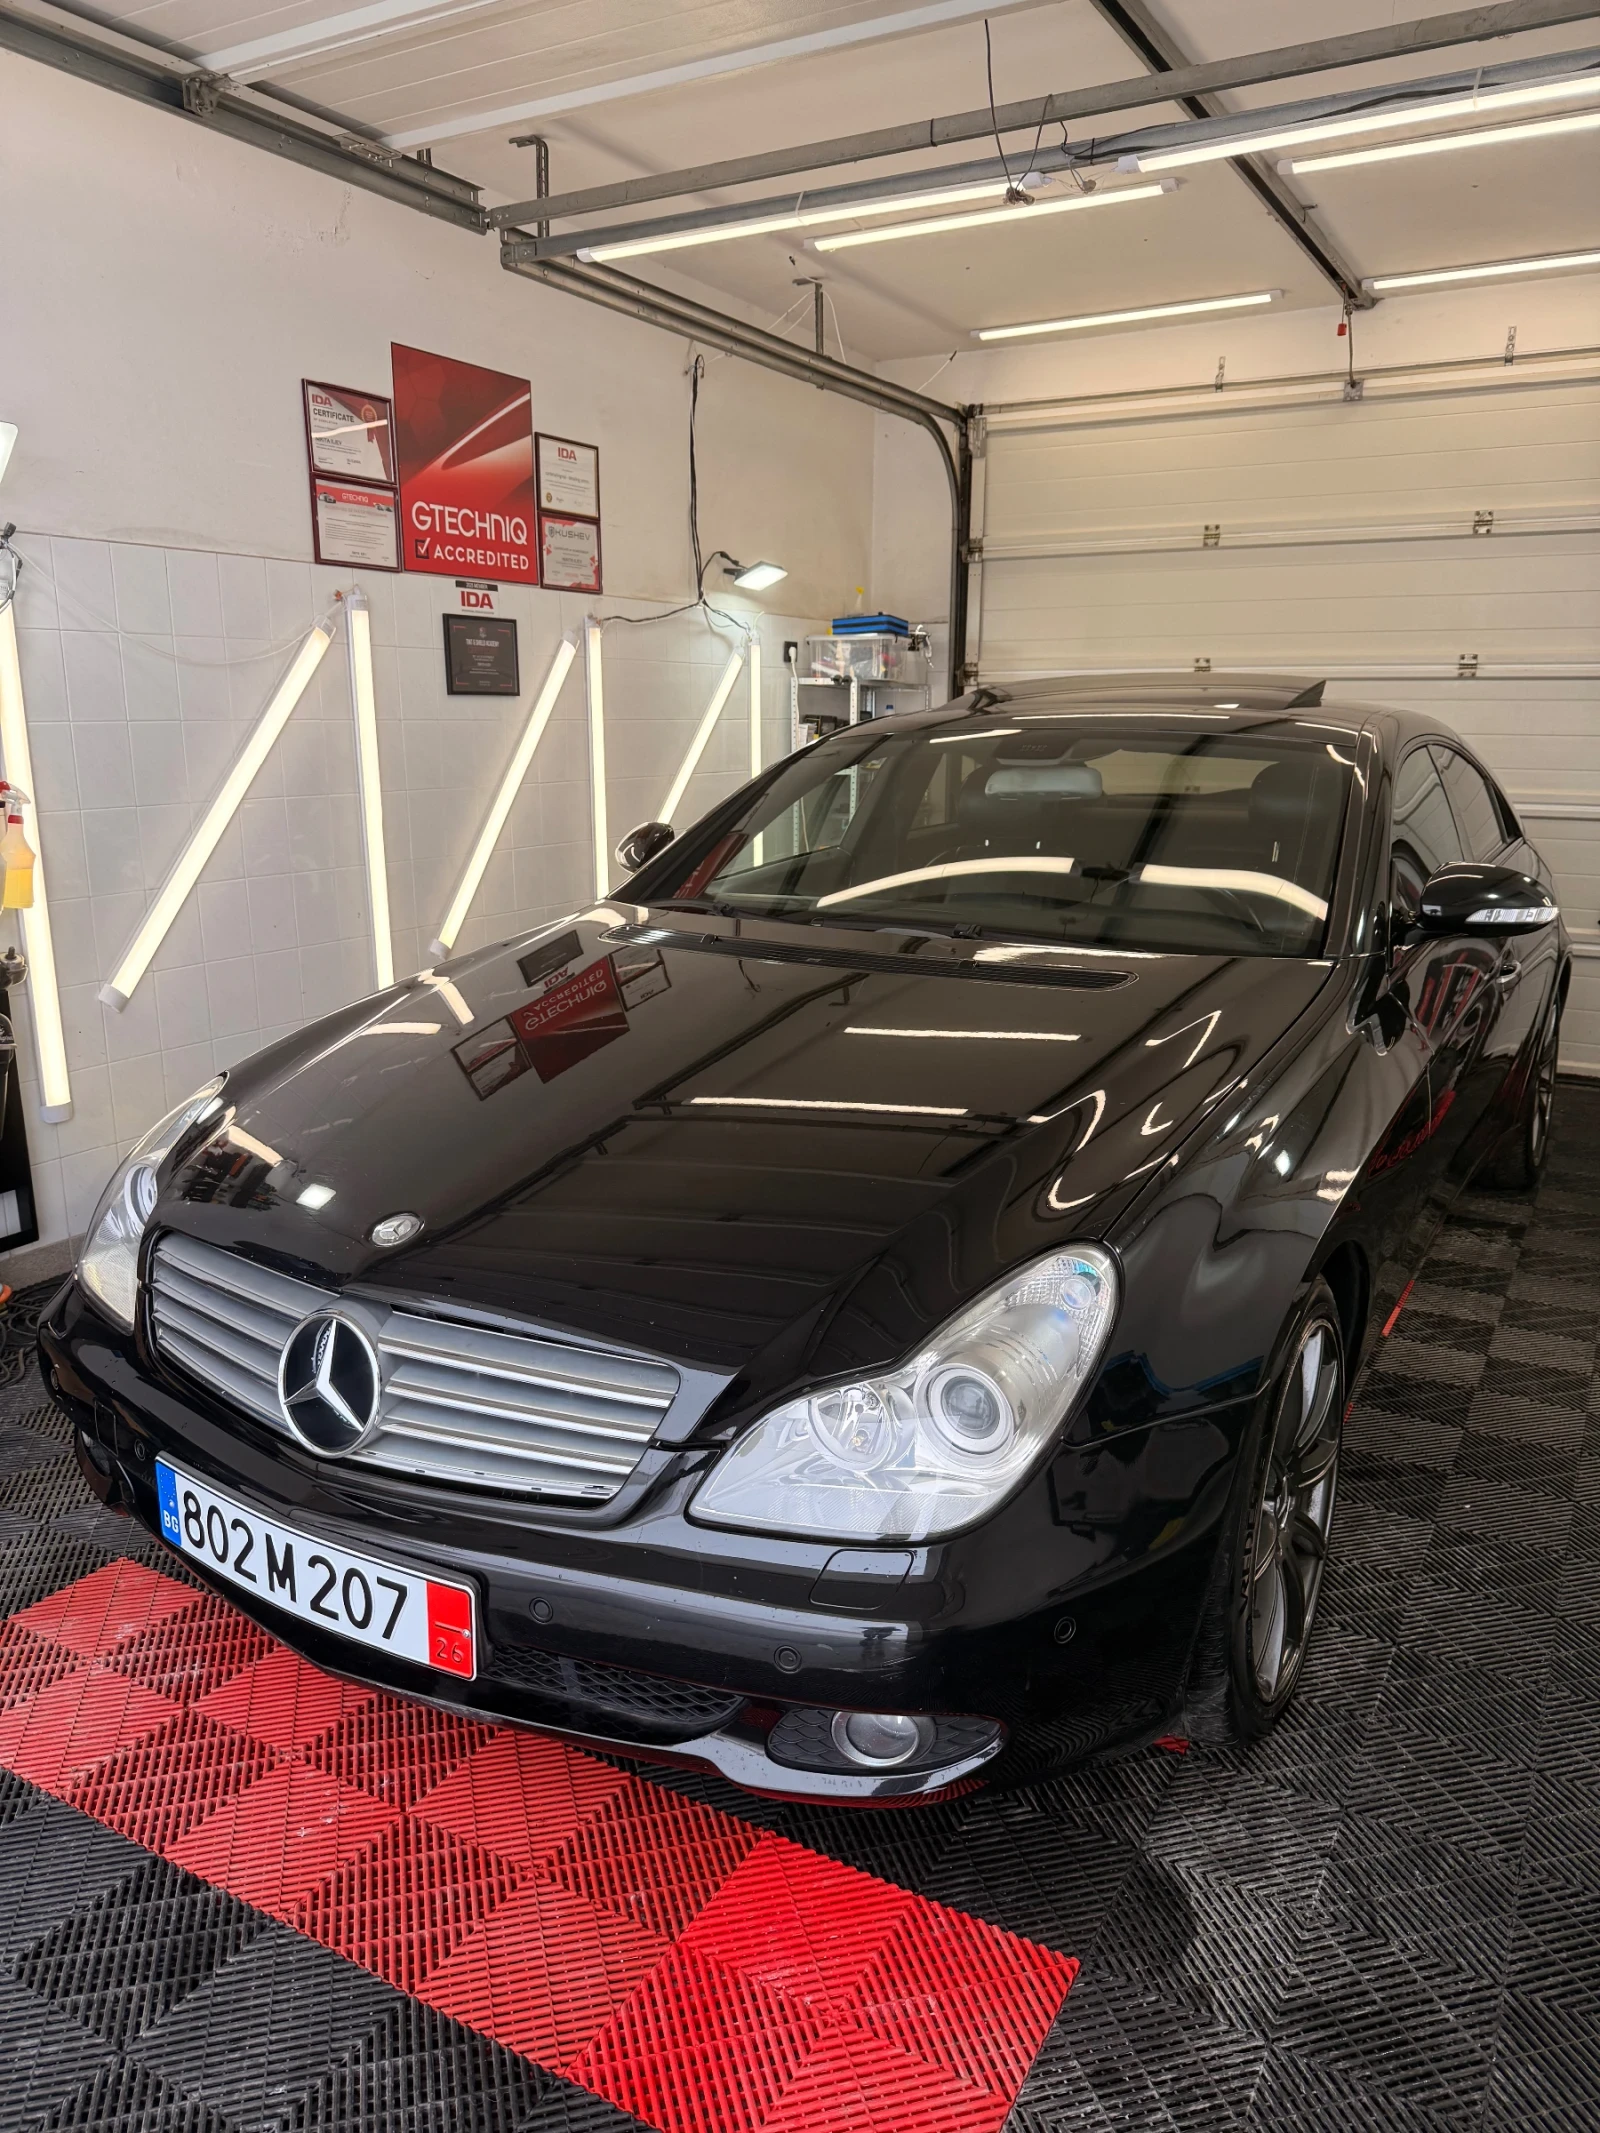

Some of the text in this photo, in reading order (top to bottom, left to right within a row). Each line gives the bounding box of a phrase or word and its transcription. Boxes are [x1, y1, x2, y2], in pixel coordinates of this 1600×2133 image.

[311, 394, 333, 407] IDA
[313, 408, 355, 423] CERTIFICATE
[557, 447, 577, 461] IDA
[341, 492, 369, 503] GTECHNIQ
[411, 500, 528, 546] GTECHNIQ
[555, 529, 591, 541] KUSHEV
[433, 544, 529, 570] ACCREDITED
[460, 591, 494, 609] IDA
[163, 1509, 179, 1534] BG
[436, 1637, 464, 1664] 26
